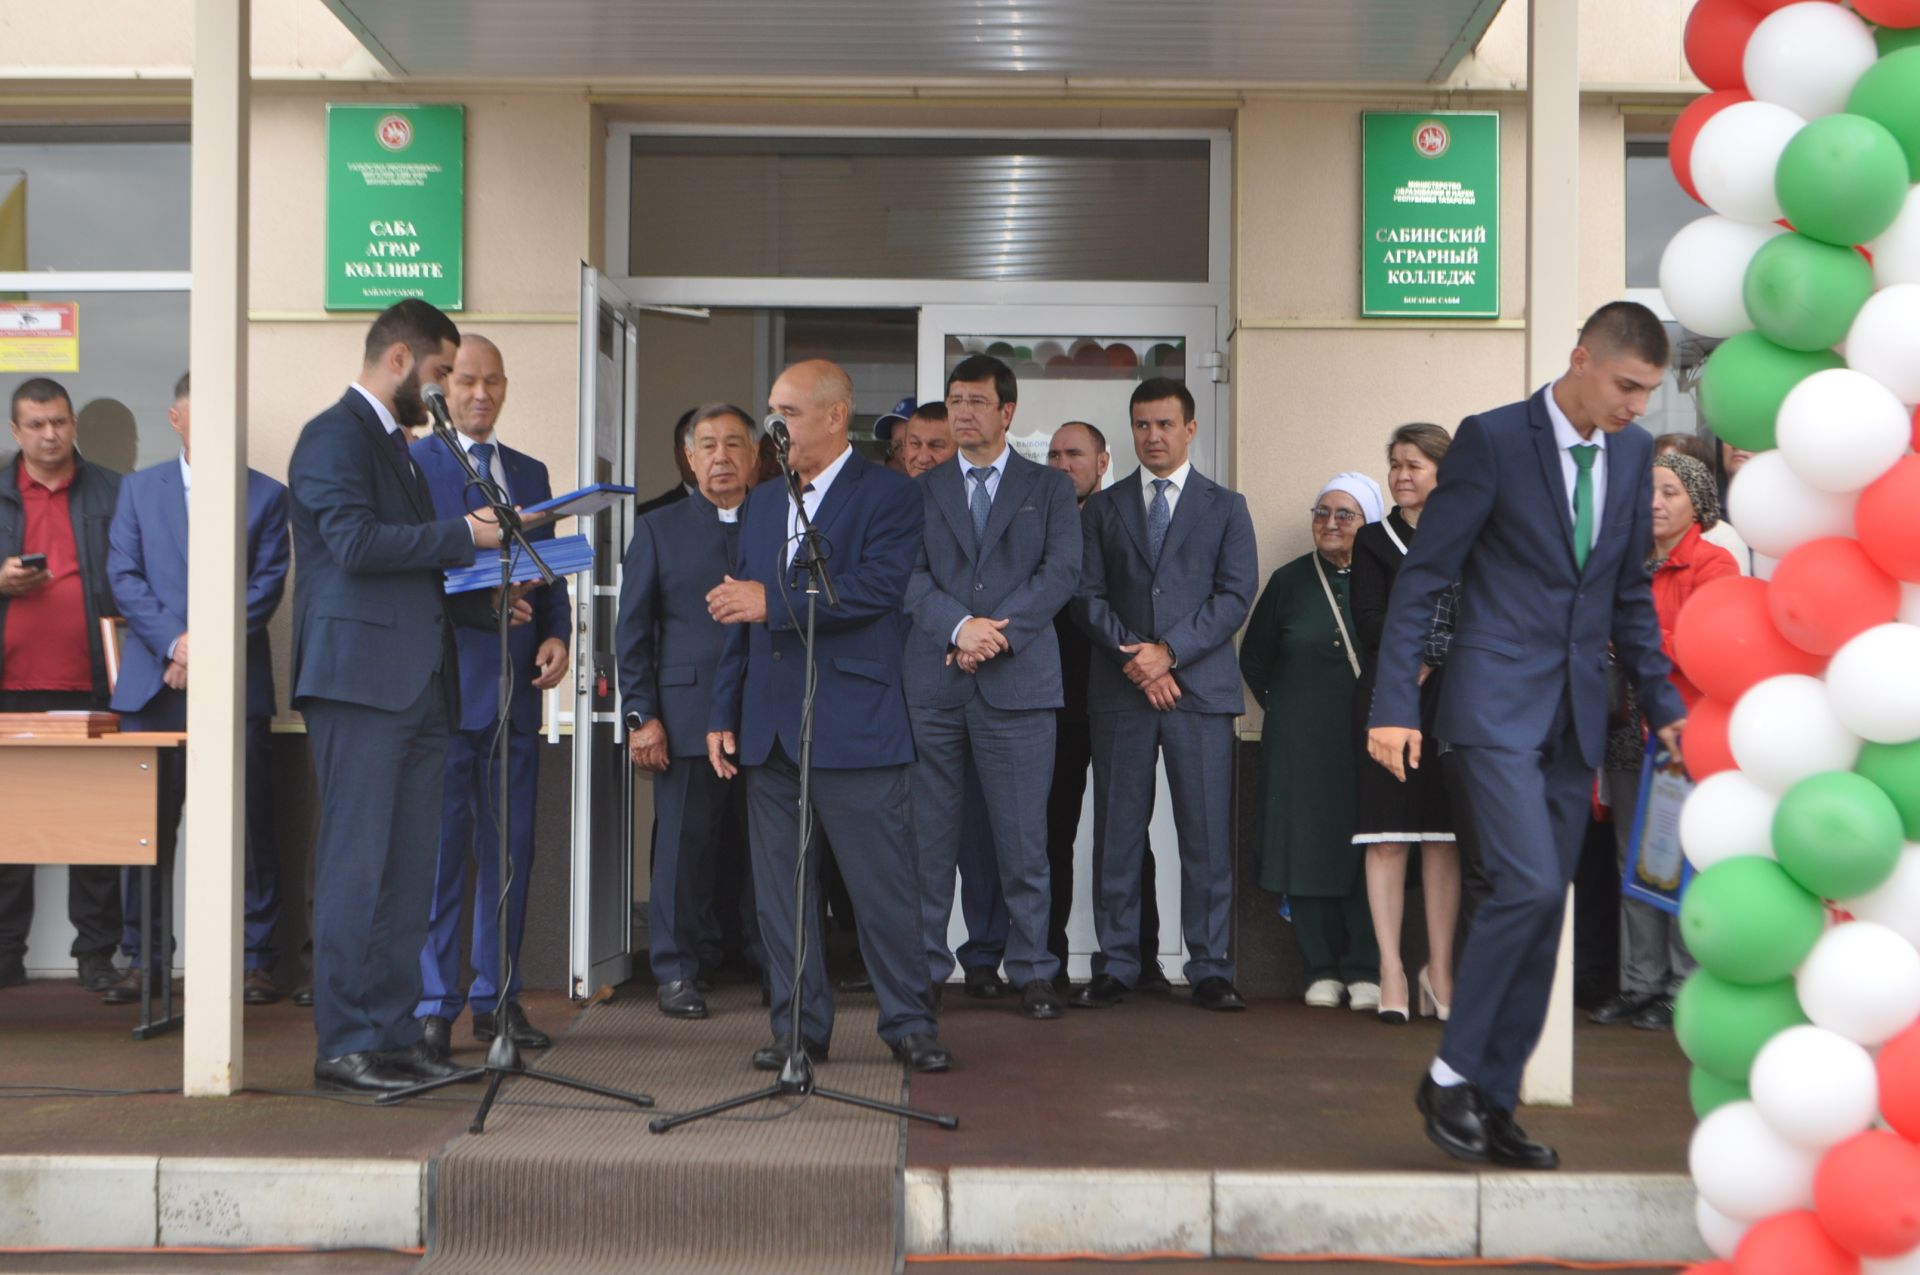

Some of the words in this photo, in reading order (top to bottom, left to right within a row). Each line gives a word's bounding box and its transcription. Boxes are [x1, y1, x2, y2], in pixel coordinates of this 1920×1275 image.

[369, 220, 417, 237] САБА
[1376, 224, 1486, 243] САБИНСКИЙ
[366, 241, 421, 257] АГРАР
[1383, 246, 1479, 264] АГРАРНЫЙ
[1388, 269, 1476, 287] КОЛЛЕДЖ
